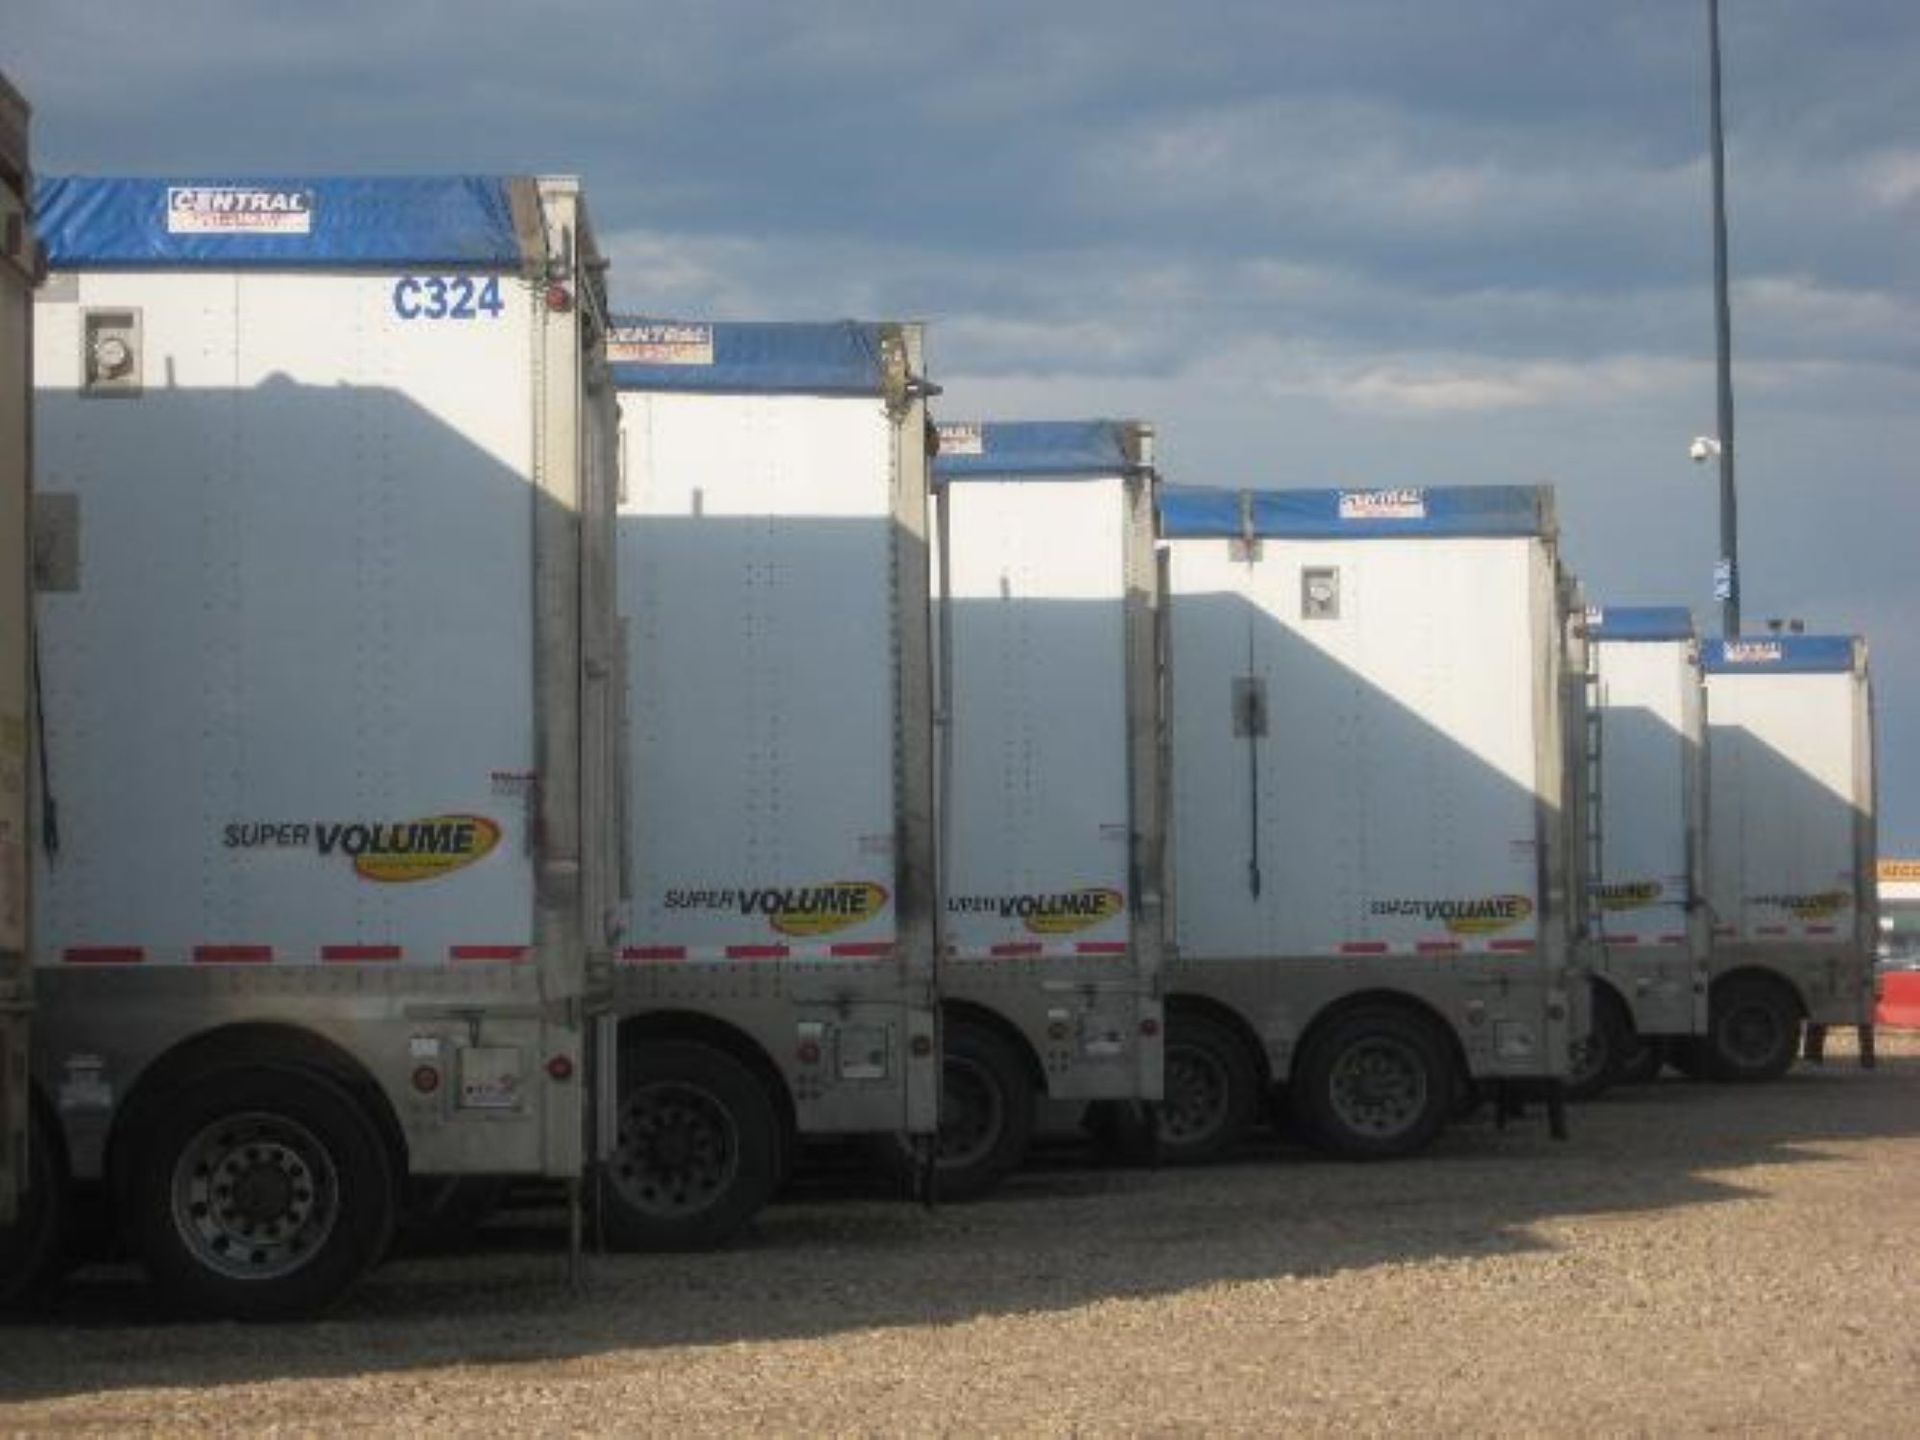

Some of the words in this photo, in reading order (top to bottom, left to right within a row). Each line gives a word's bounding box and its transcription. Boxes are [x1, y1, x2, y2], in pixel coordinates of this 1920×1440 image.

[172, 189, 305, 212] CENTRAL
[393, 277, 505, 319] C324
[223, 824, 309, 848] SUPER
[314, 823, 477, 854] VOLUME
[665, 889, 734, 909] SUPER
[737, 887, 868, 914] VOLUME
